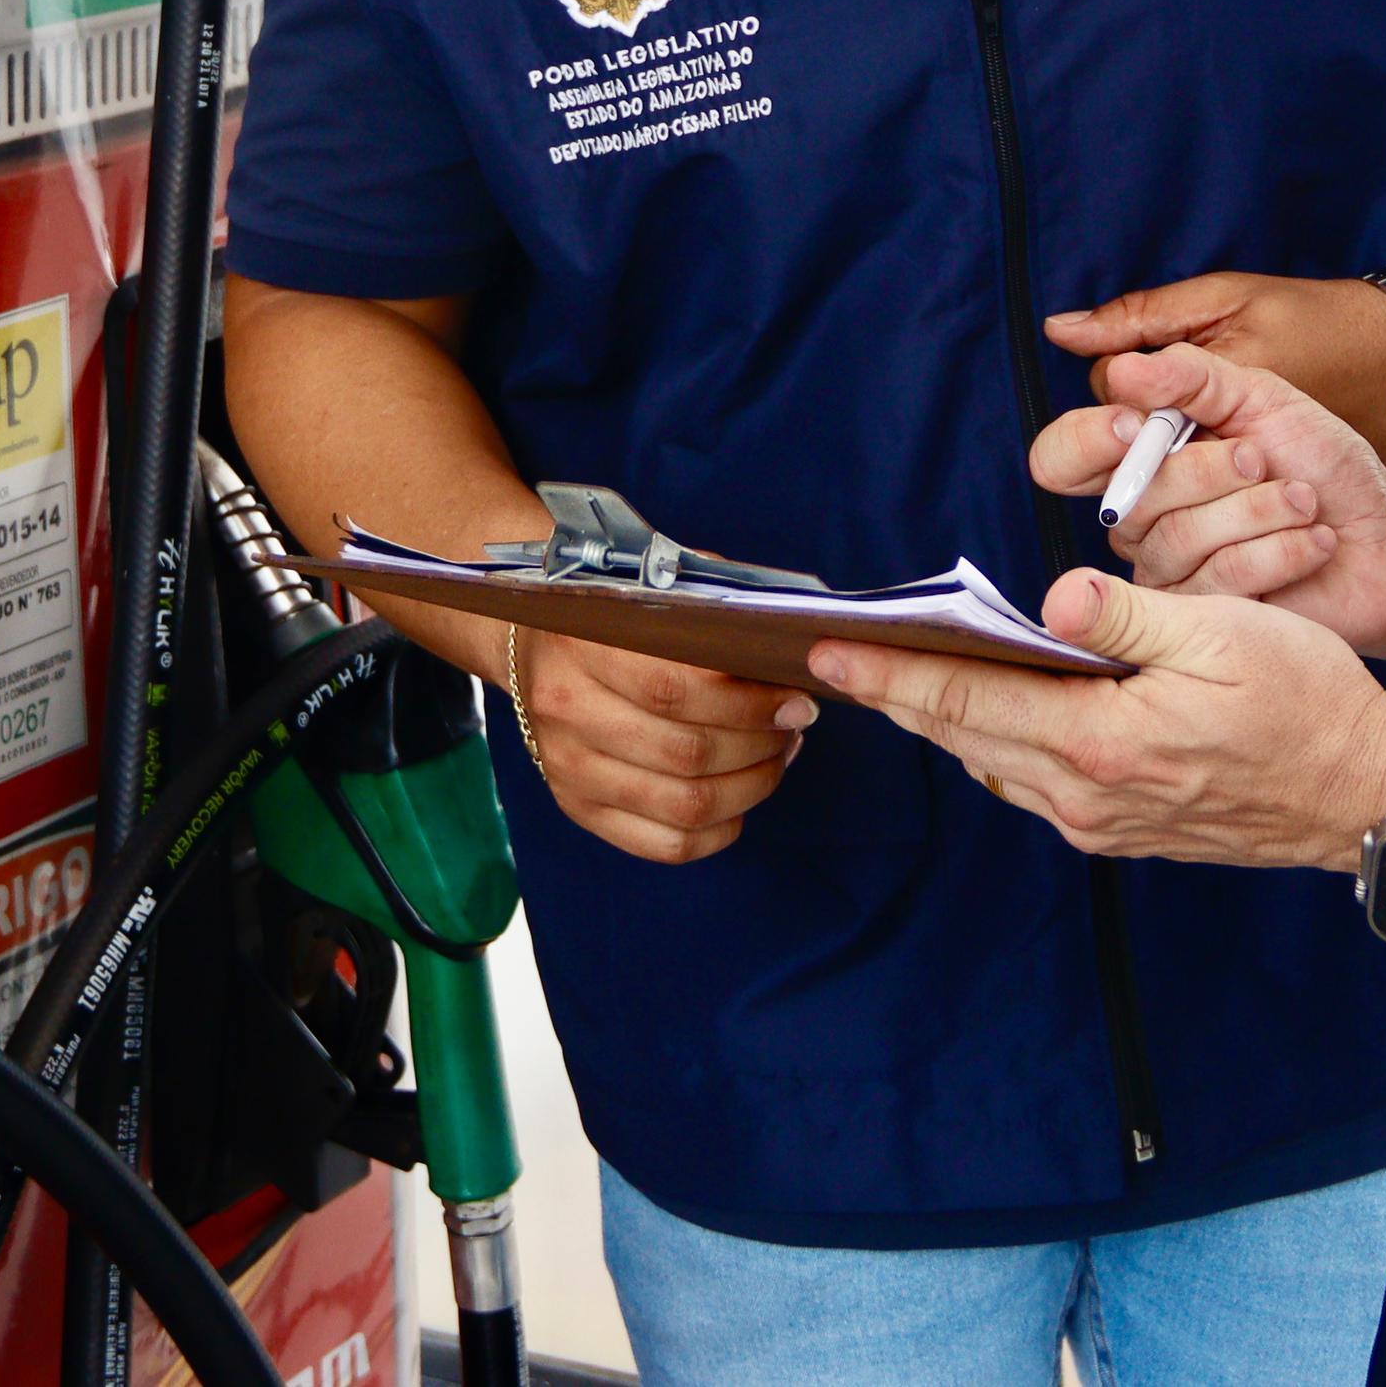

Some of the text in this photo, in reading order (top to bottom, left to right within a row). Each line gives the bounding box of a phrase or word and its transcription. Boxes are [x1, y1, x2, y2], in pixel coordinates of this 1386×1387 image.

[528, 15, 760, 89] PODER LEGISLATIVO
[629, 51, 726, 93] LEGISLATIVA
[727, 46, 753, 69] DO
[549, 133, 623, 165] DEPUTADO
[671, 109, 721, 137] CÉSAR
[723, 97, 773, 125] FILHO
[565, 71, 742, 130] ESTADO DO AMAZONAS
[37, 581, 60, 603] 763
[0, 697, 50, 744] 0267
[166, 790, 227, 869] RECOVERY
[77, 930, 133, 1012] MH65061
